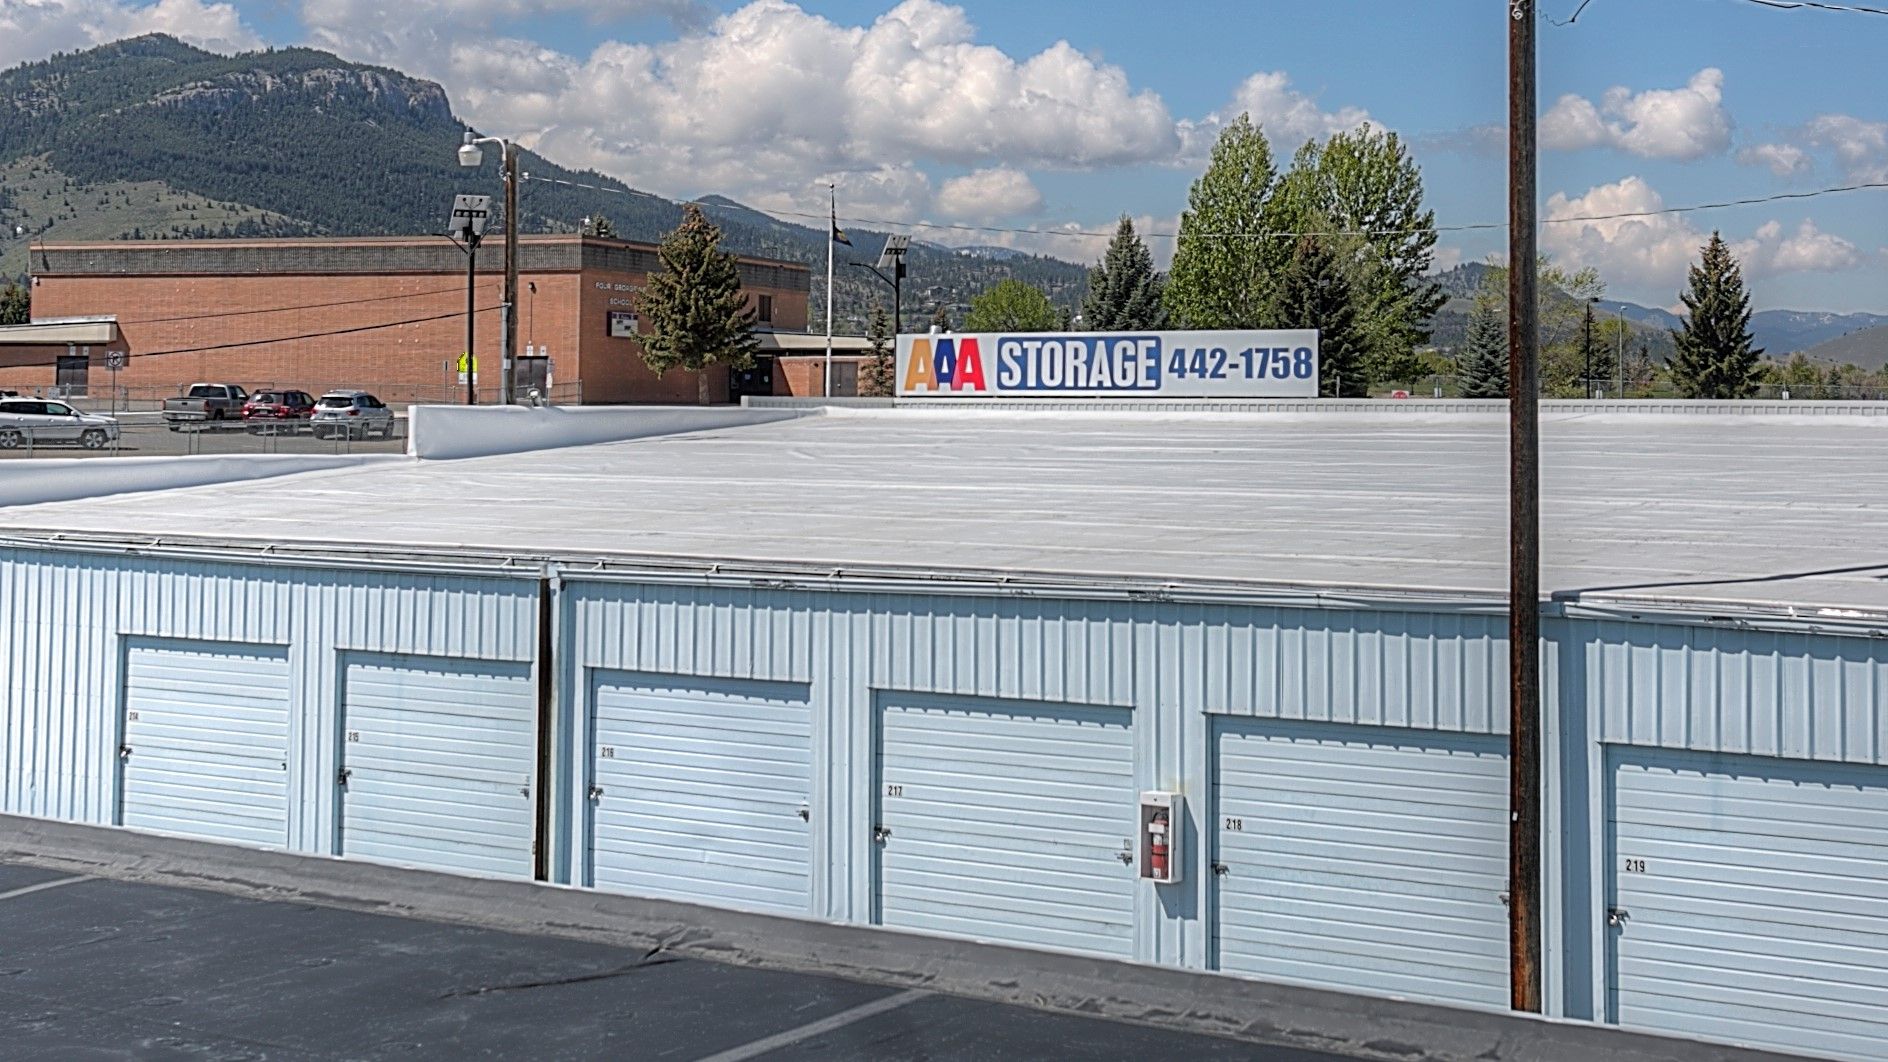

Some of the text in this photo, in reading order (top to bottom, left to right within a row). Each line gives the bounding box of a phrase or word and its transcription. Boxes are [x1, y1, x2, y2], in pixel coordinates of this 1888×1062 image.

[595, 282, 611, 290] FOUR
[609, 298, 632, 306] SCHOOL
[904, 338, 1313, 391] AAA STORAGE 442-1758
[602, 746, 614, 758] 216
[888, 785, 902, 796] 217
[1226, 818, 1242, 831] 218
[1626, 859, 1645, 873] 219
